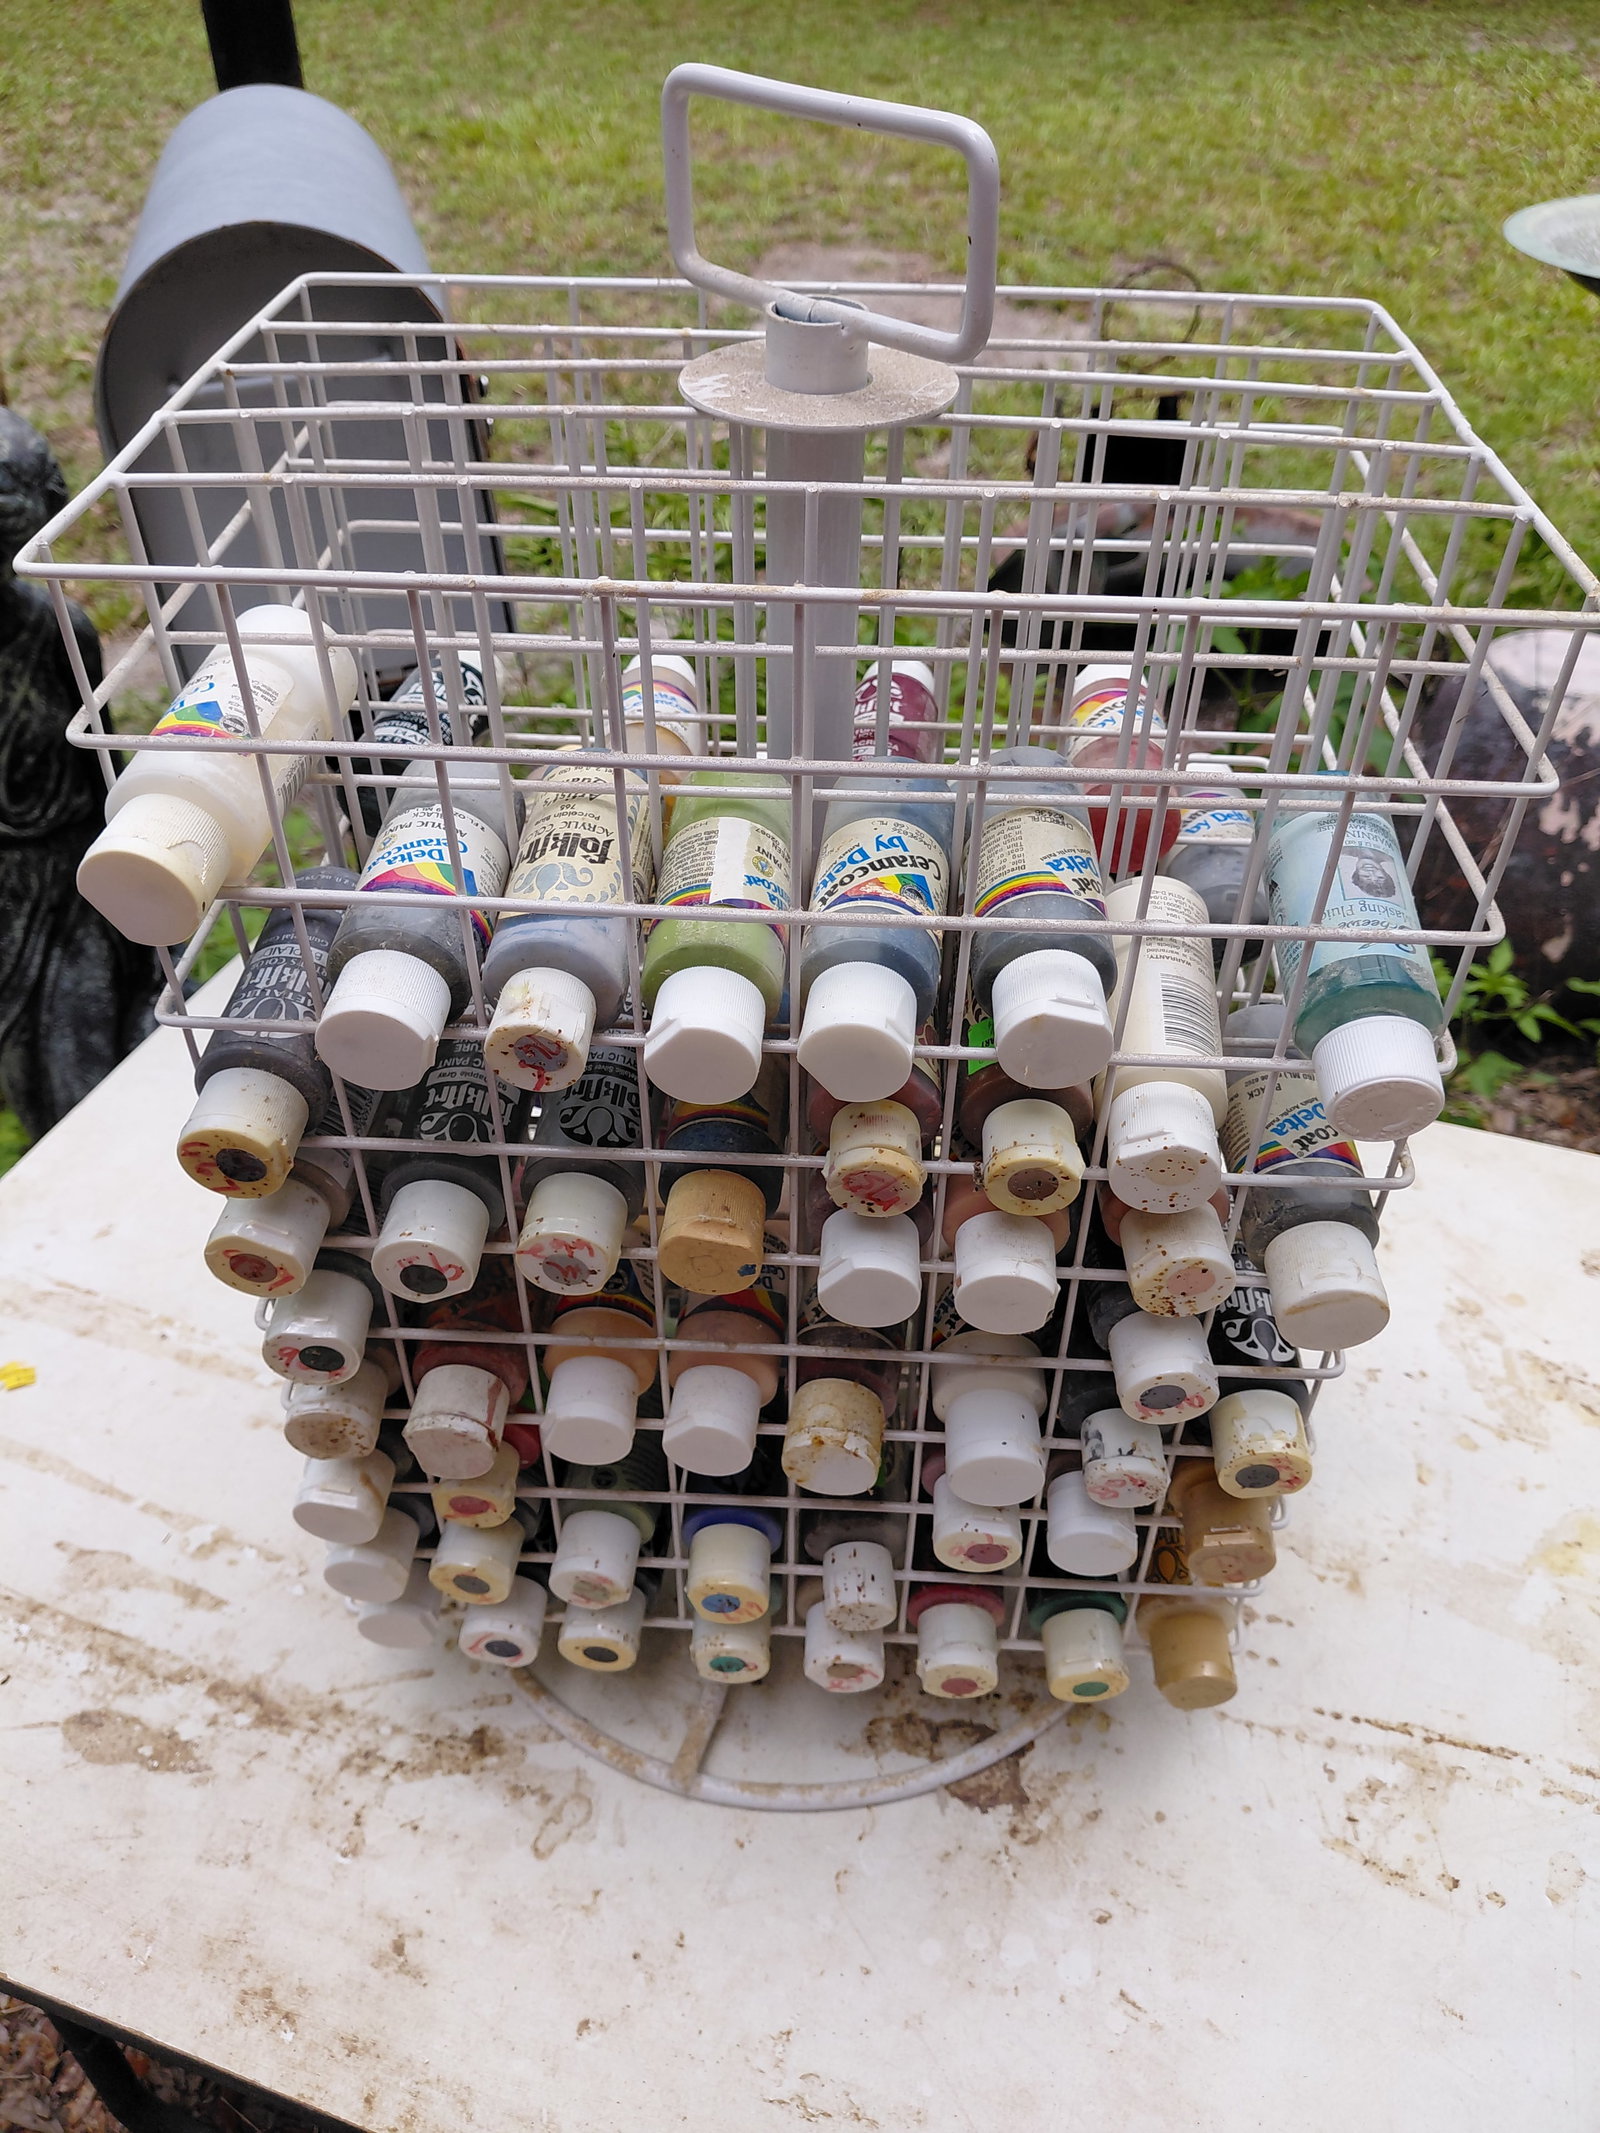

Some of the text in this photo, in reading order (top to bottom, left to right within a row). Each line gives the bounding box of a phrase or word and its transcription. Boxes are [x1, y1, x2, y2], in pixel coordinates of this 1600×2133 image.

[553, 811, 601, 820] Porcelain
[558, 820, 614, 838] ACRYLIC
[366, 838, 468, 873] Ceramcoat
[385, 848, 444, 867] Delta
[755, 846, 782, 870] PAINT
[812, 834, 909, 900] by Delta
[1045, 855, 1098, 878] Delta
[817, 855, 941, 908] Ceramcoat
[436, 1057, 470, 1068] PAINT
[556, 1076, 640, 1111] olkArt
[1246, 1082, 1282, 1100] BACK
